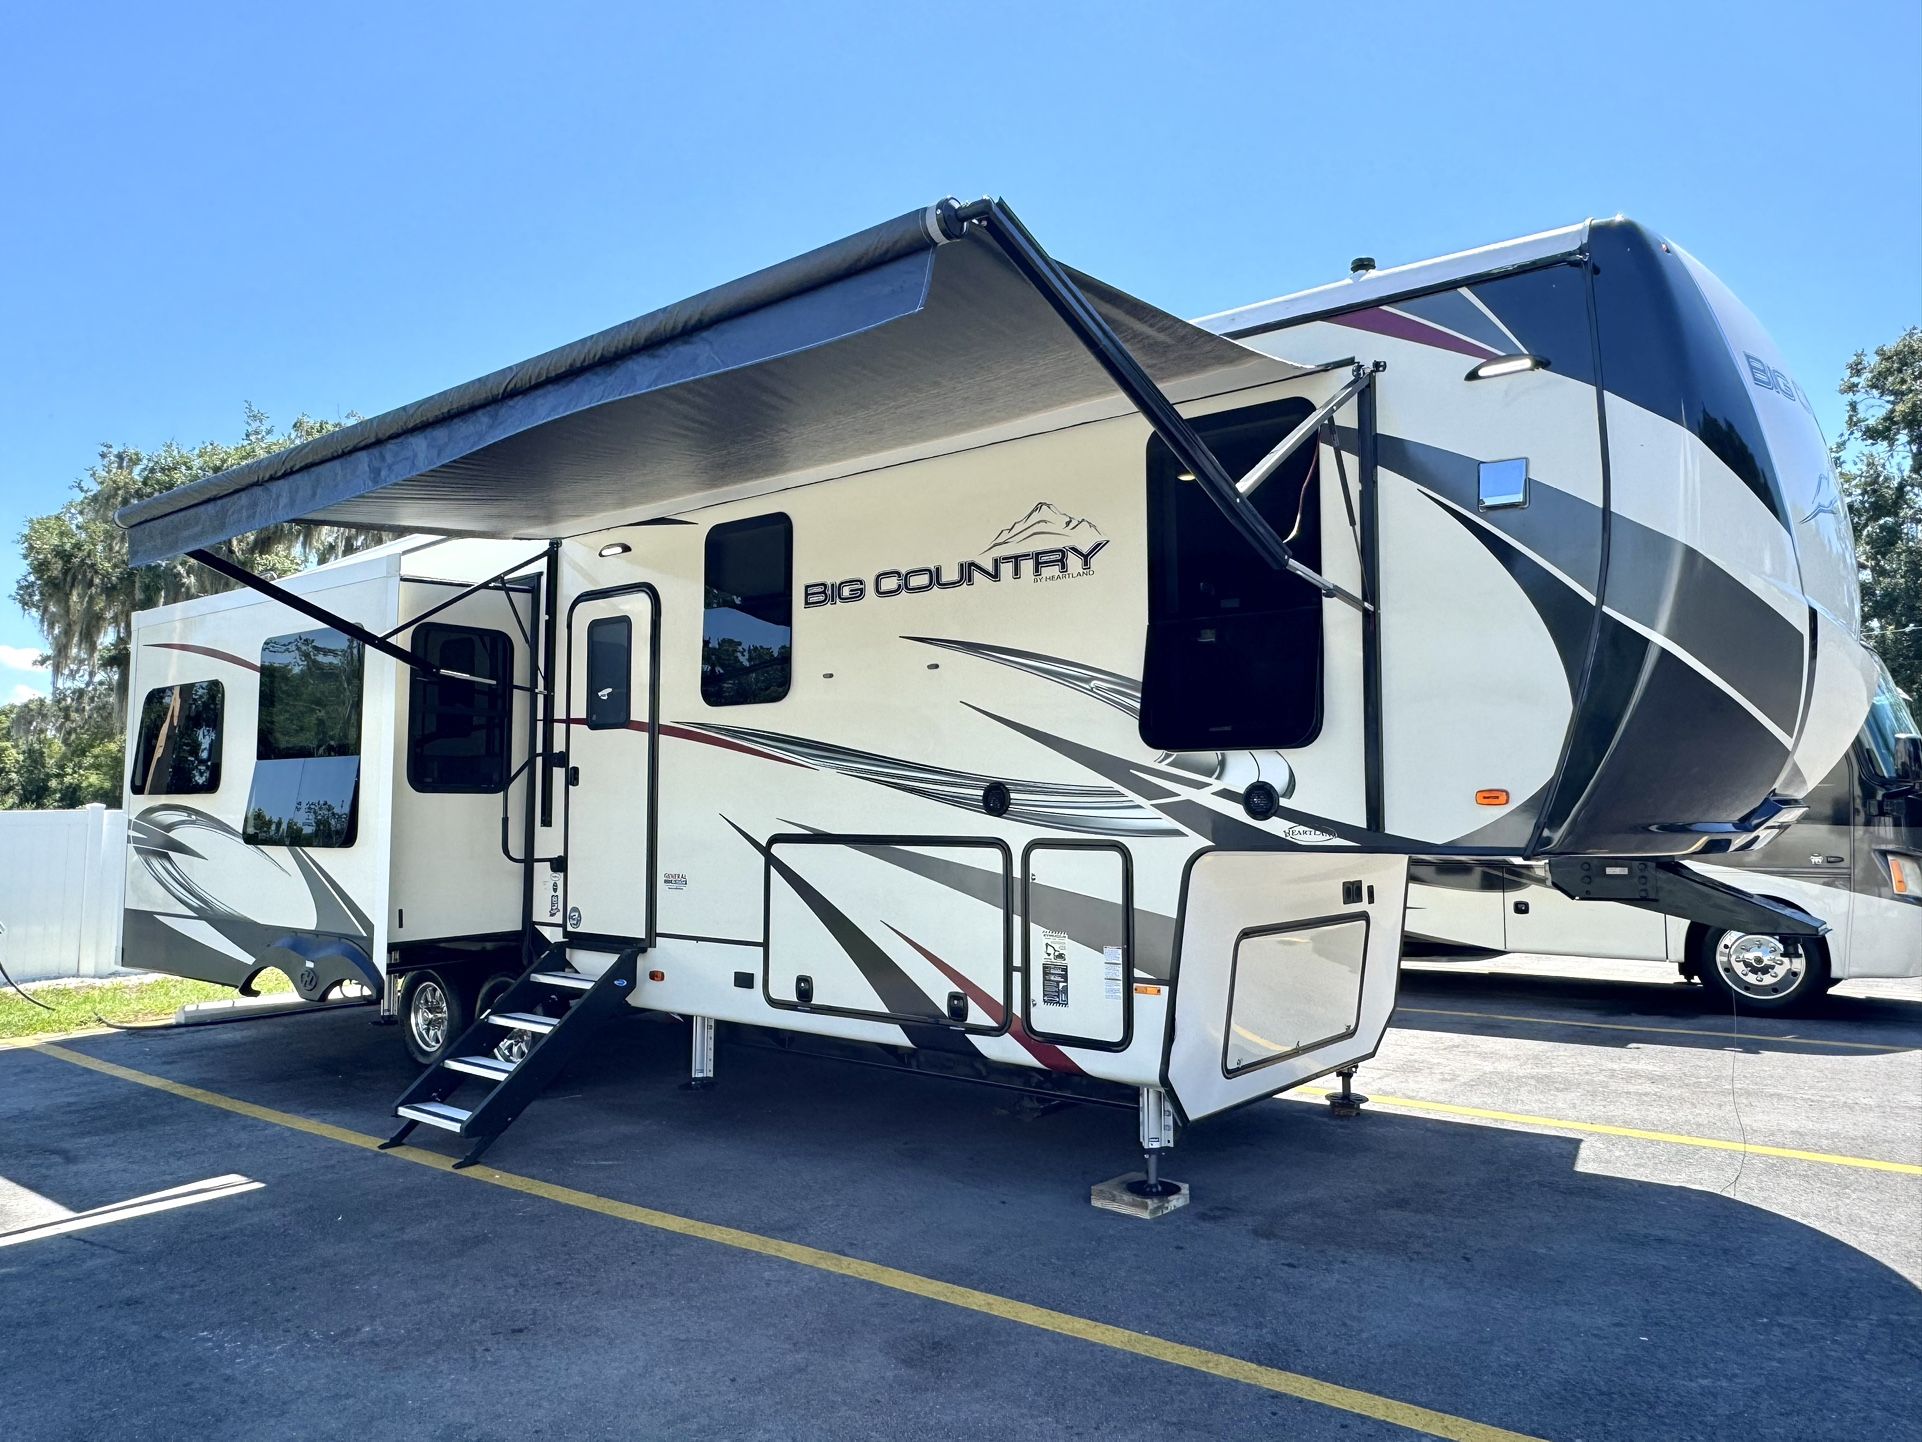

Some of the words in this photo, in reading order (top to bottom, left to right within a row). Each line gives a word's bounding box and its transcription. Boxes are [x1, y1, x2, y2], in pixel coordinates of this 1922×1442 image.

[1743, 351, 1796, 402] BIG
[803, 577, 866, 609] BIG
[873, 539, 1110, 598] COUNTRY
[1045, 569, 1095, 582] HEARTLAND
